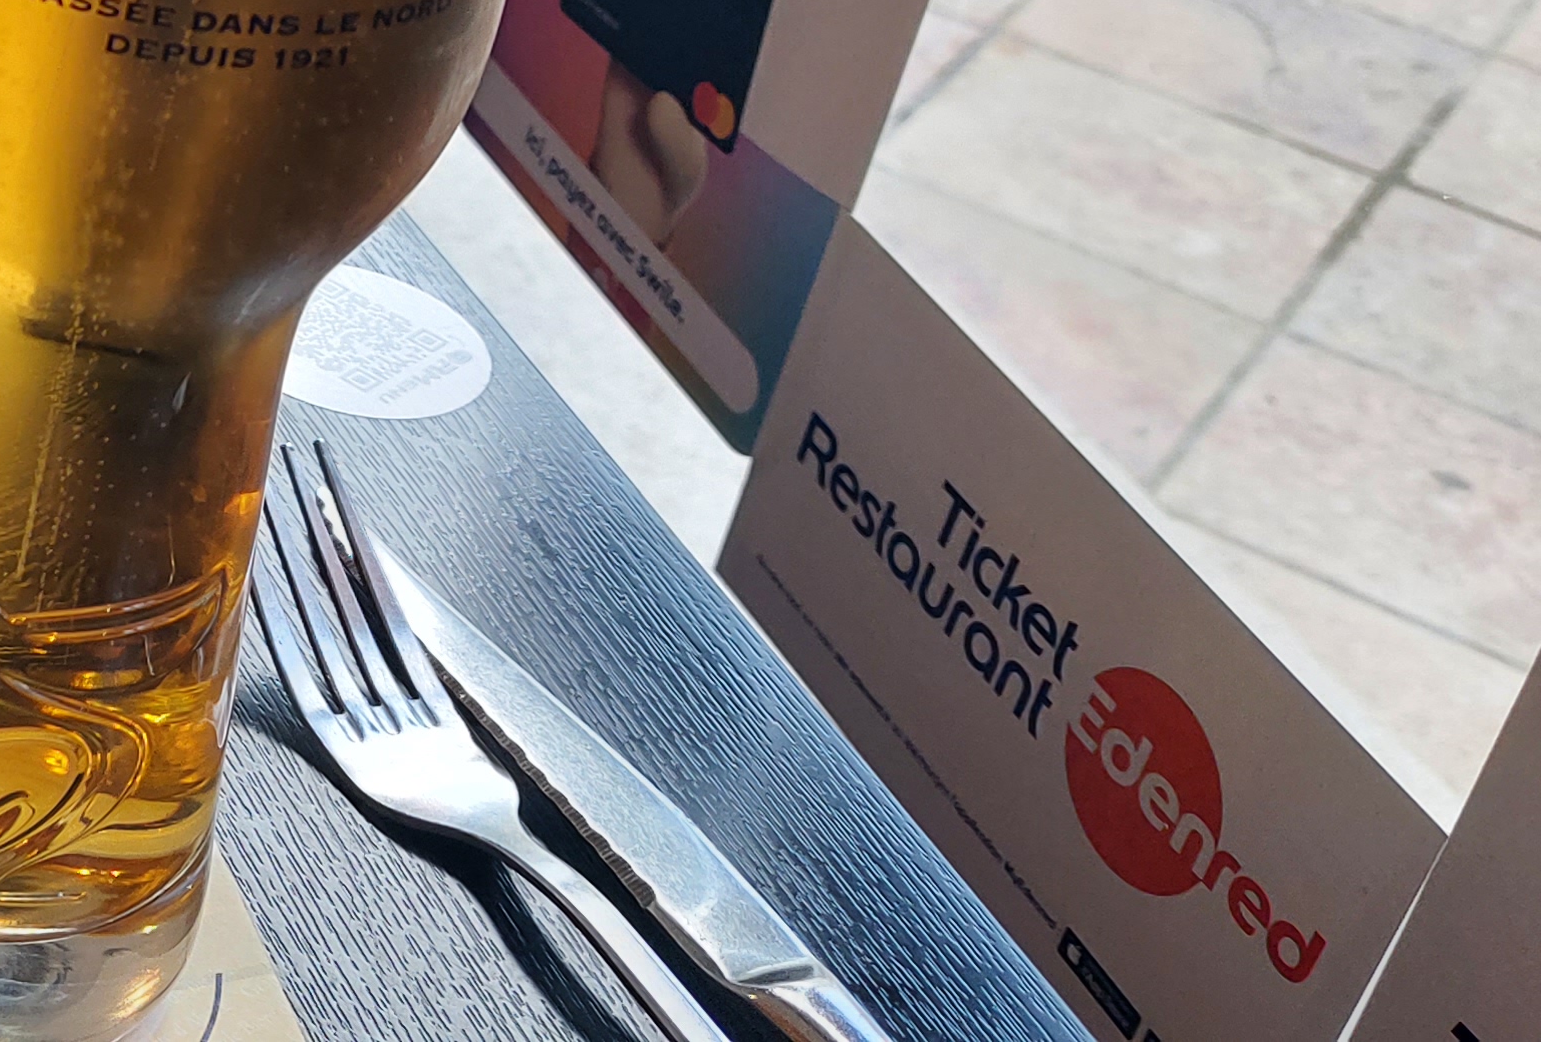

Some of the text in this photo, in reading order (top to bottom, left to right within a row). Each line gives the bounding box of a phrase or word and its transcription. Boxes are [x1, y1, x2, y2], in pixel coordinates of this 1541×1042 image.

[105, 32, 349, 70] DEPUIS 1921
[192, 10, 301, 37] DANS
[314, 11, 362, 36] LE
[796, 411, 1053, 741] Restaurant
[940, 478, 1079, 684] Ticket
[1067, 690, 1326, 984] Edenred
